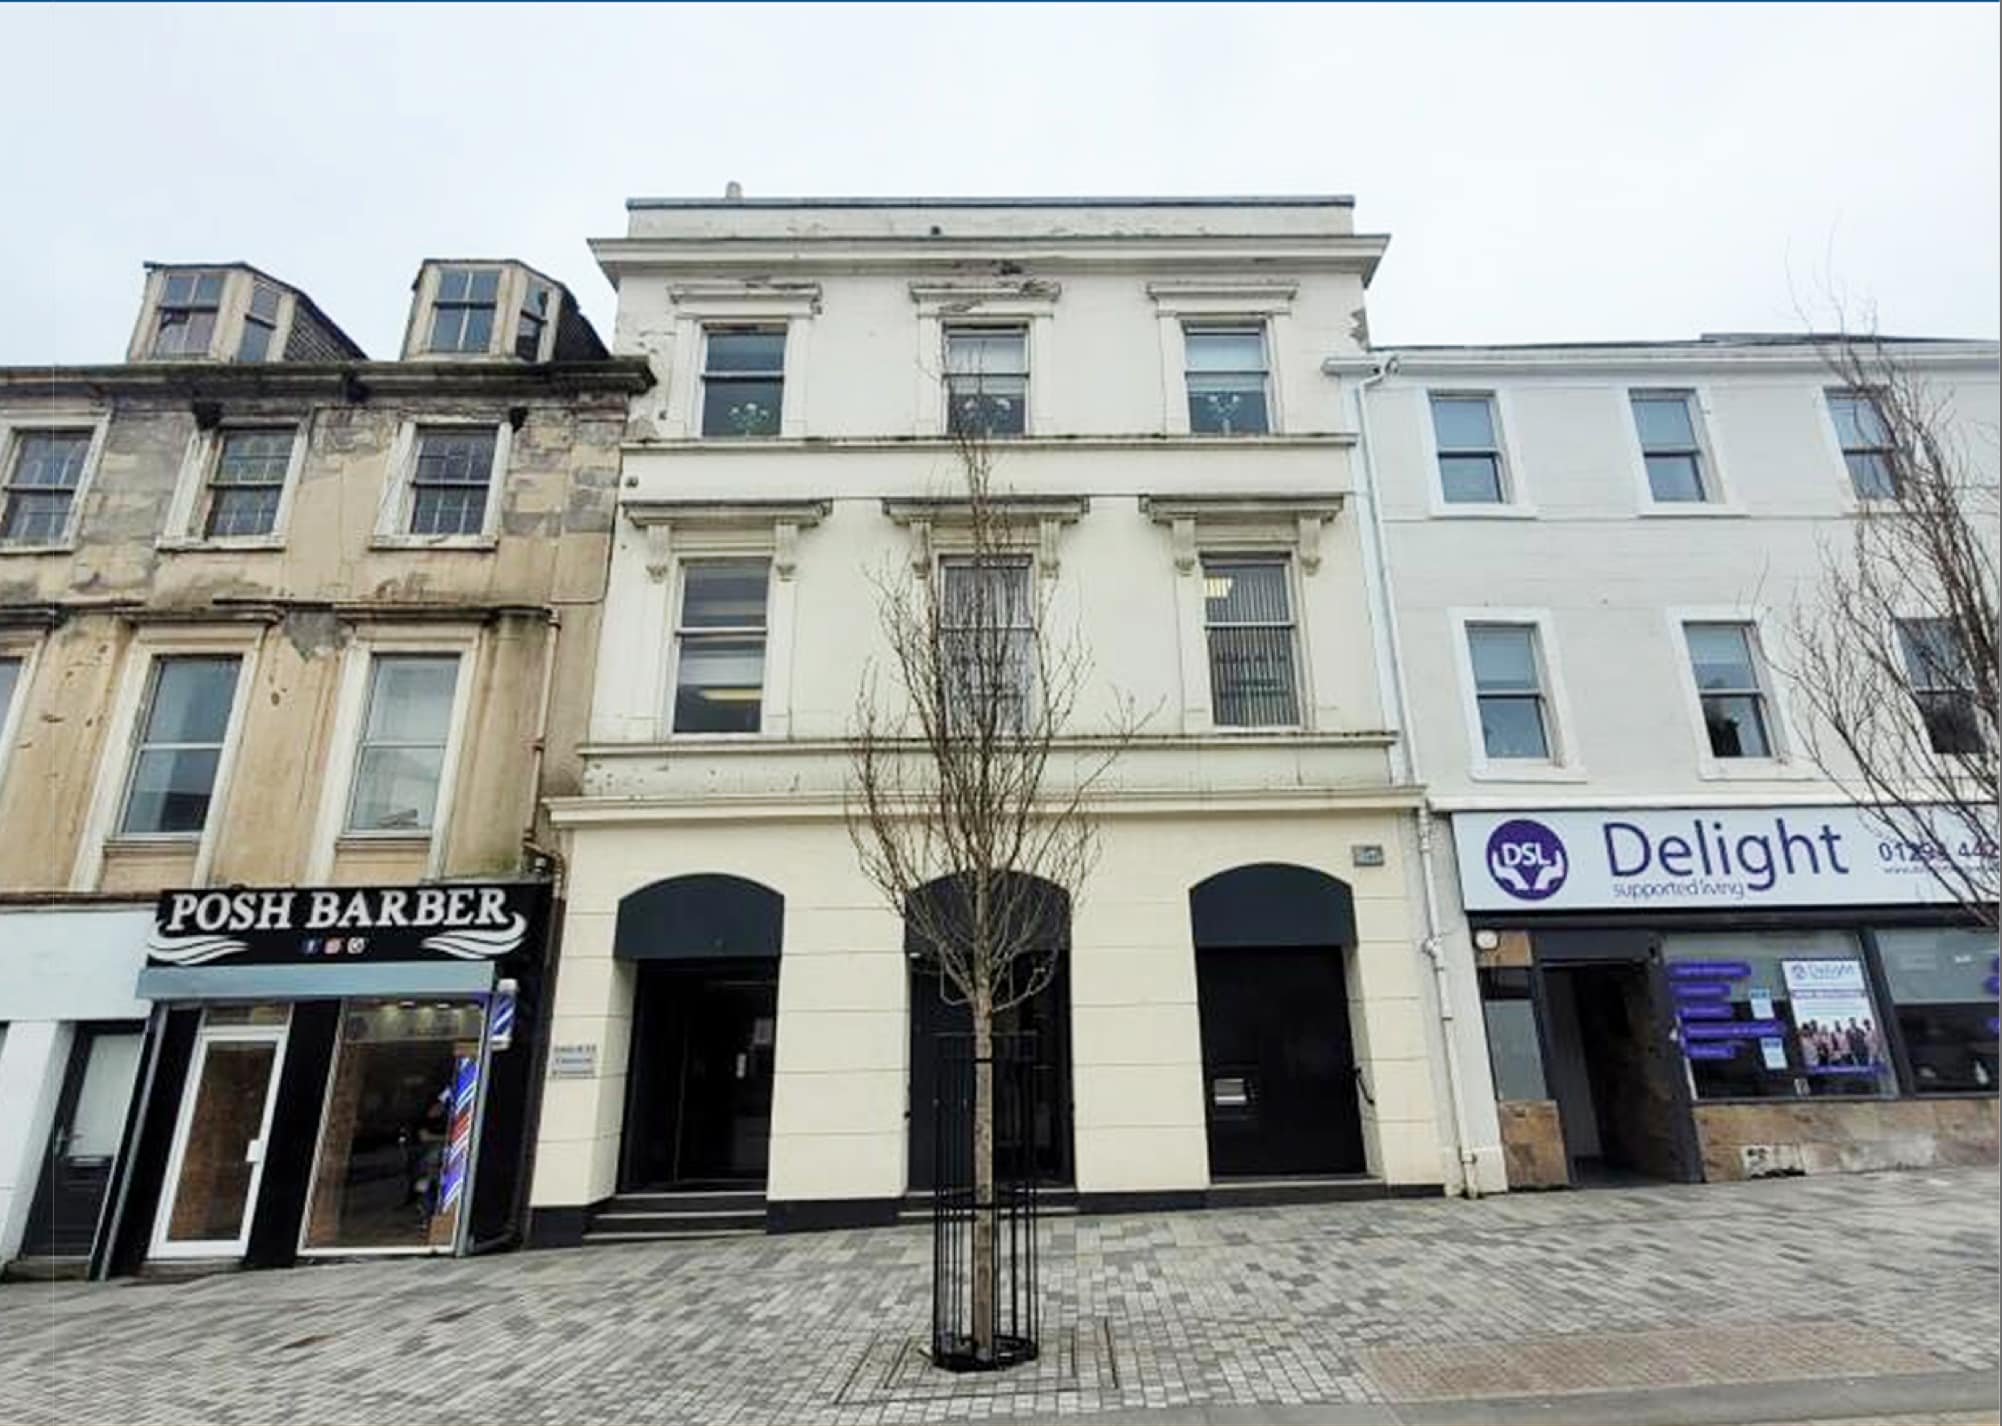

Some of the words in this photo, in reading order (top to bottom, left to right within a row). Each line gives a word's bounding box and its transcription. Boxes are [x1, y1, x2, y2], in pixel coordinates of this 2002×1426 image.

[1502, 842, 1552, 867] DSL
[1603, 817, 1850, 892] Delight
[1612, 879, 1698, 899] supported
[1698, 879, 1745, 899] living
[165, 890, 298, 932] POSH
[305, 887, 509, 929] BARBER
